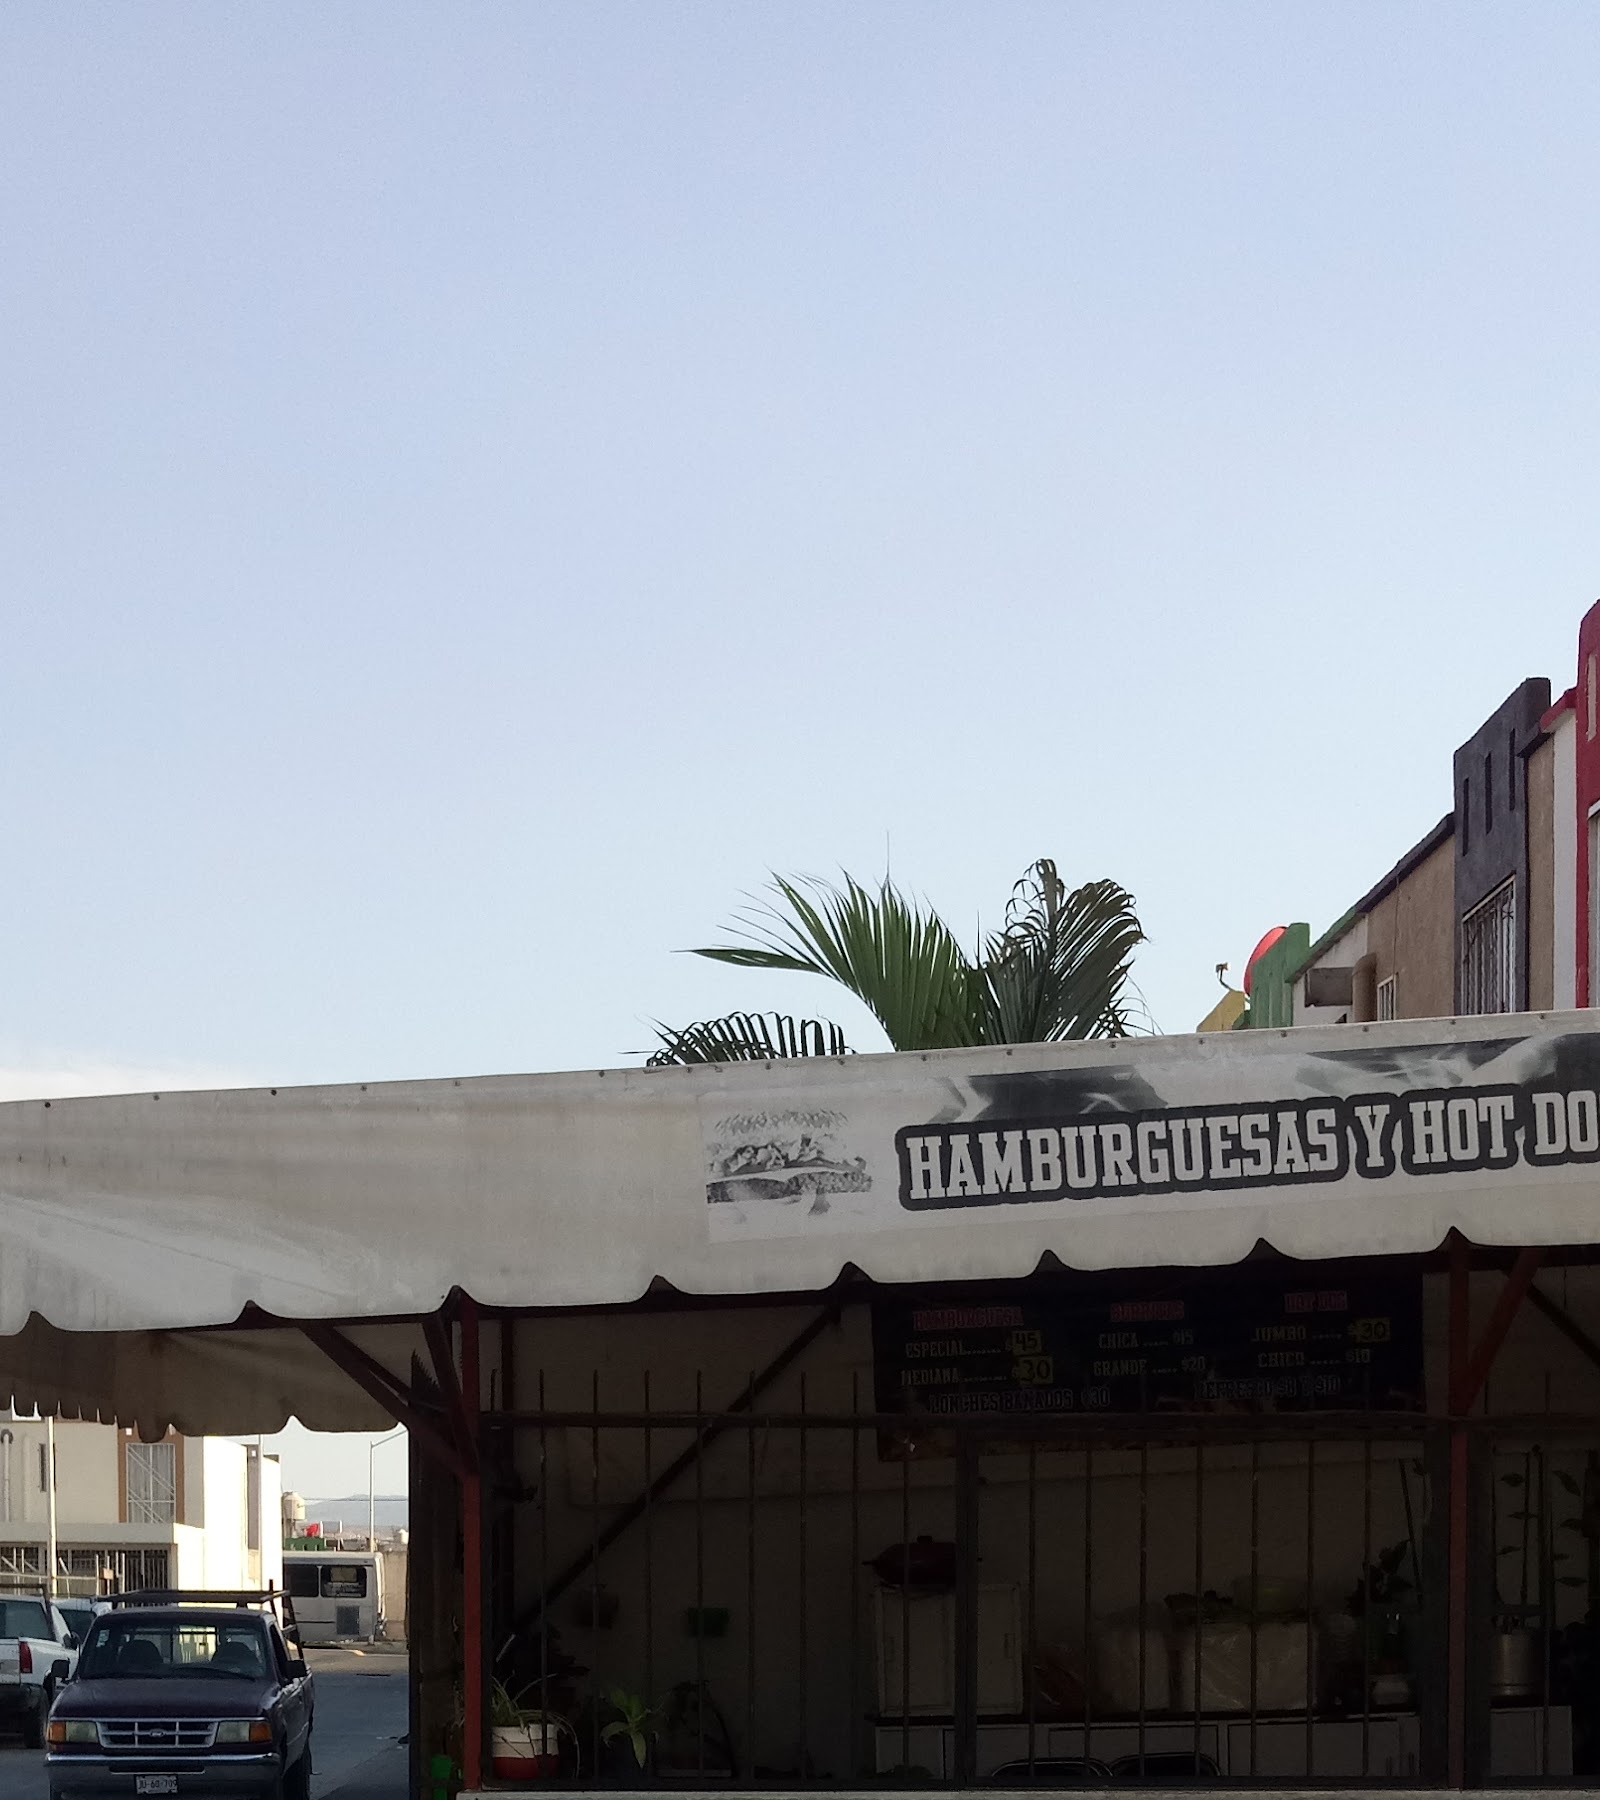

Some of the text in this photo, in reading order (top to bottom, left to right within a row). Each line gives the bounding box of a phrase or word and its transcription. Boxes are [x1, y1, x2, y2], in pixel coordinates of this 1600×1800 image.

[906, 1107, 1339, 1200] HAMBURGUESAS
[1356, 1104, 1390, 1169] Y
[1408, 1095, 1517, 1163] HOT
